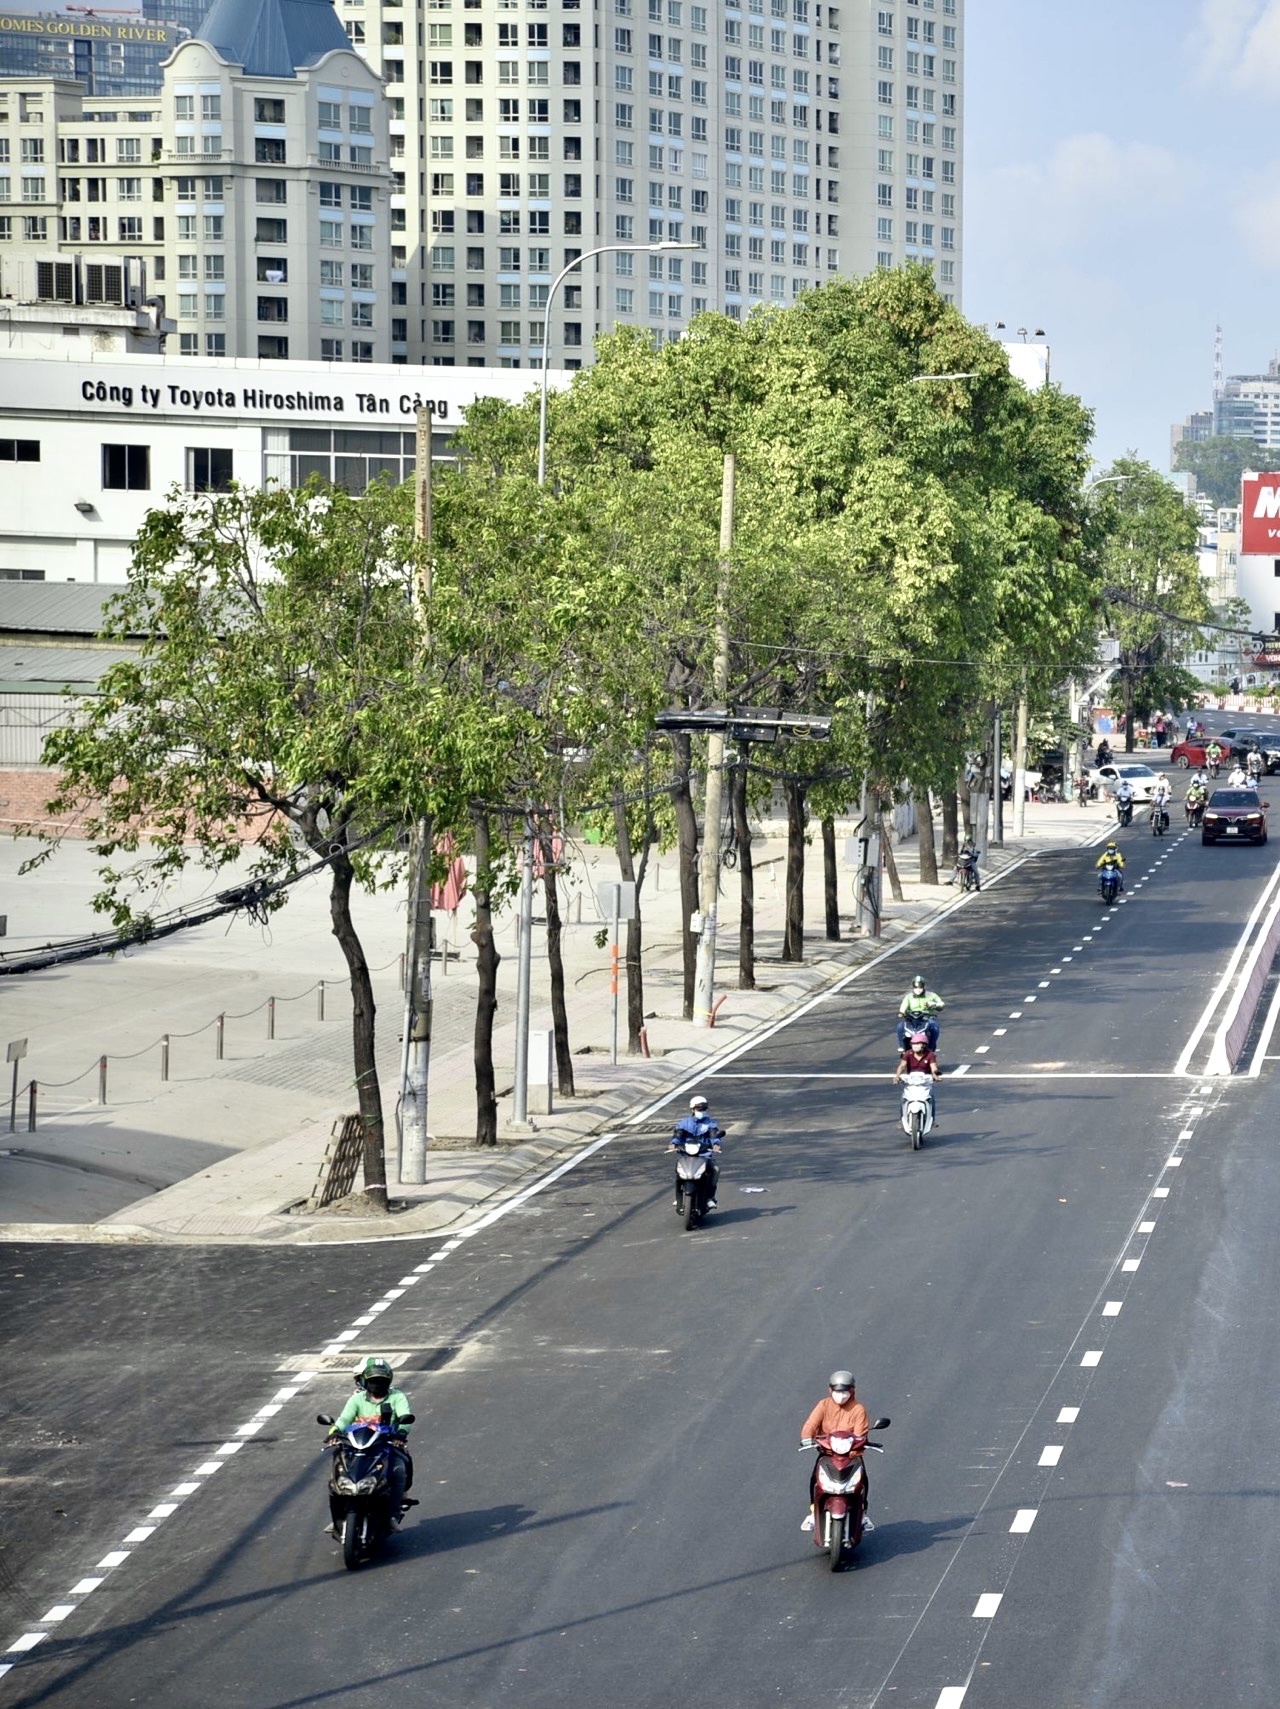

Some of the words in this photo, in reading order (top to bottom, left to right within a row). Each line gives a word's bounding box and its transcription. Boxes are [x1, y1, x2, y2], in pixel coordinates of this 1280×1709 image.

[47, 21, 112, 39] GOLDEN
[118, 26, 167, 42] RIVER
[81, 380, 133, 408] Công
[141, 384, 161, 409] ty
[167, 385, 236, 410] Toyota
[243, 388, 345, 412] Hiroshima
[355, 393, 390, 414] Tân
[399, 392, 448, 420] Cảng
